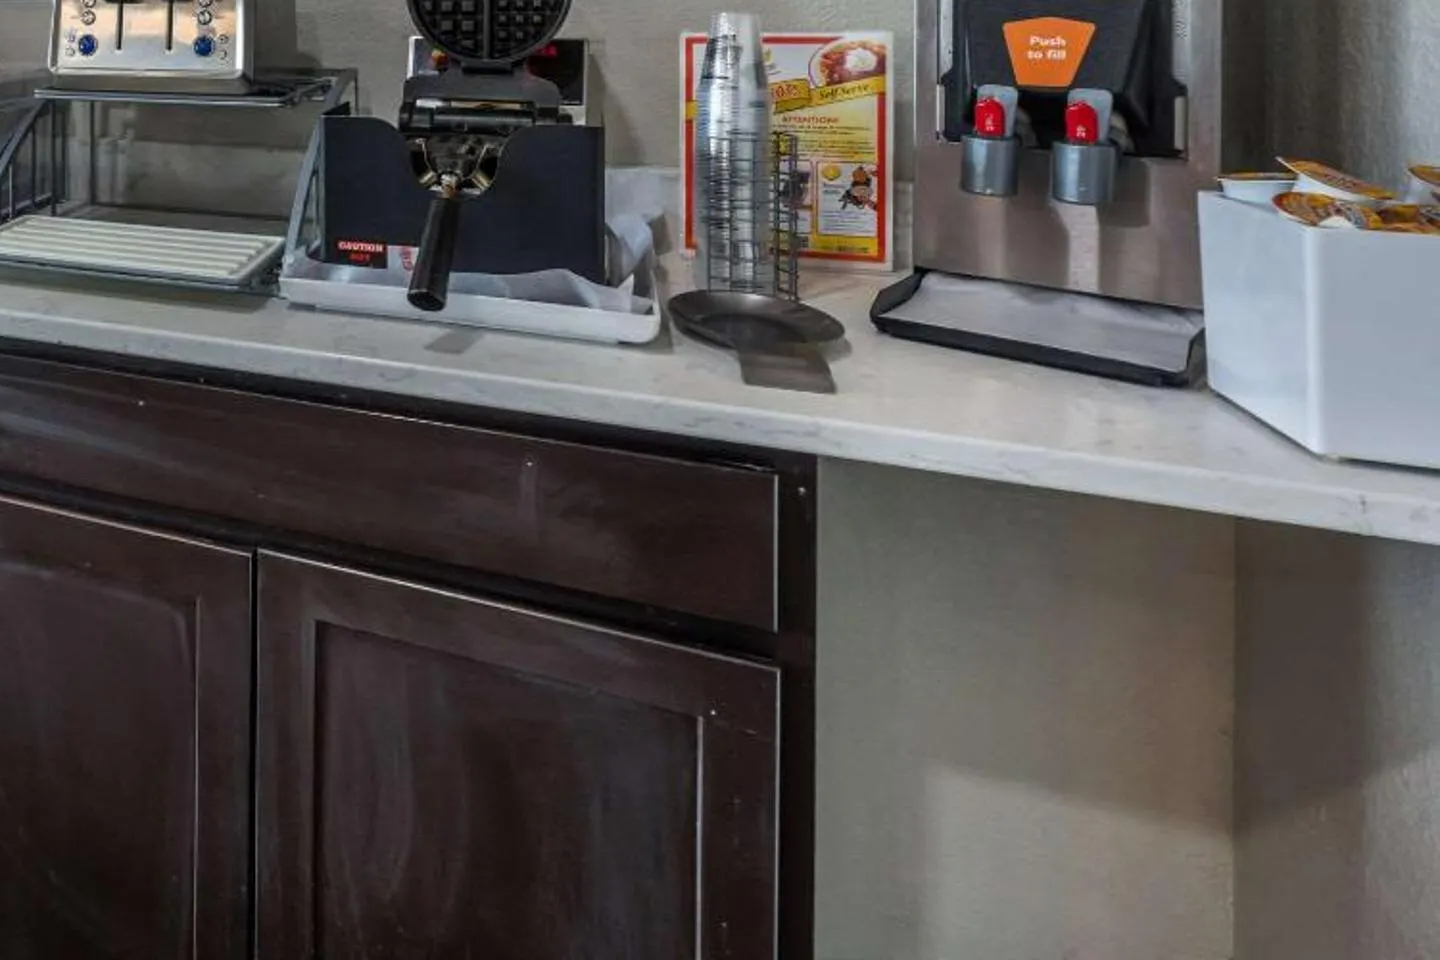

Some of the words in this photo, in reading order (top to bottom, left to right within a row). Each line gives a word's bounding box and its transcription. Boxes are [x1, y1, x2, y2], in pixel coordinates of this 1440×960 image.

[1029, 36, 1067, 47] Push
[1027, 50, 1043, 60] to
[1047, 48, 1067, 60] fill
[338, 241, 383, 253] CAUTION
